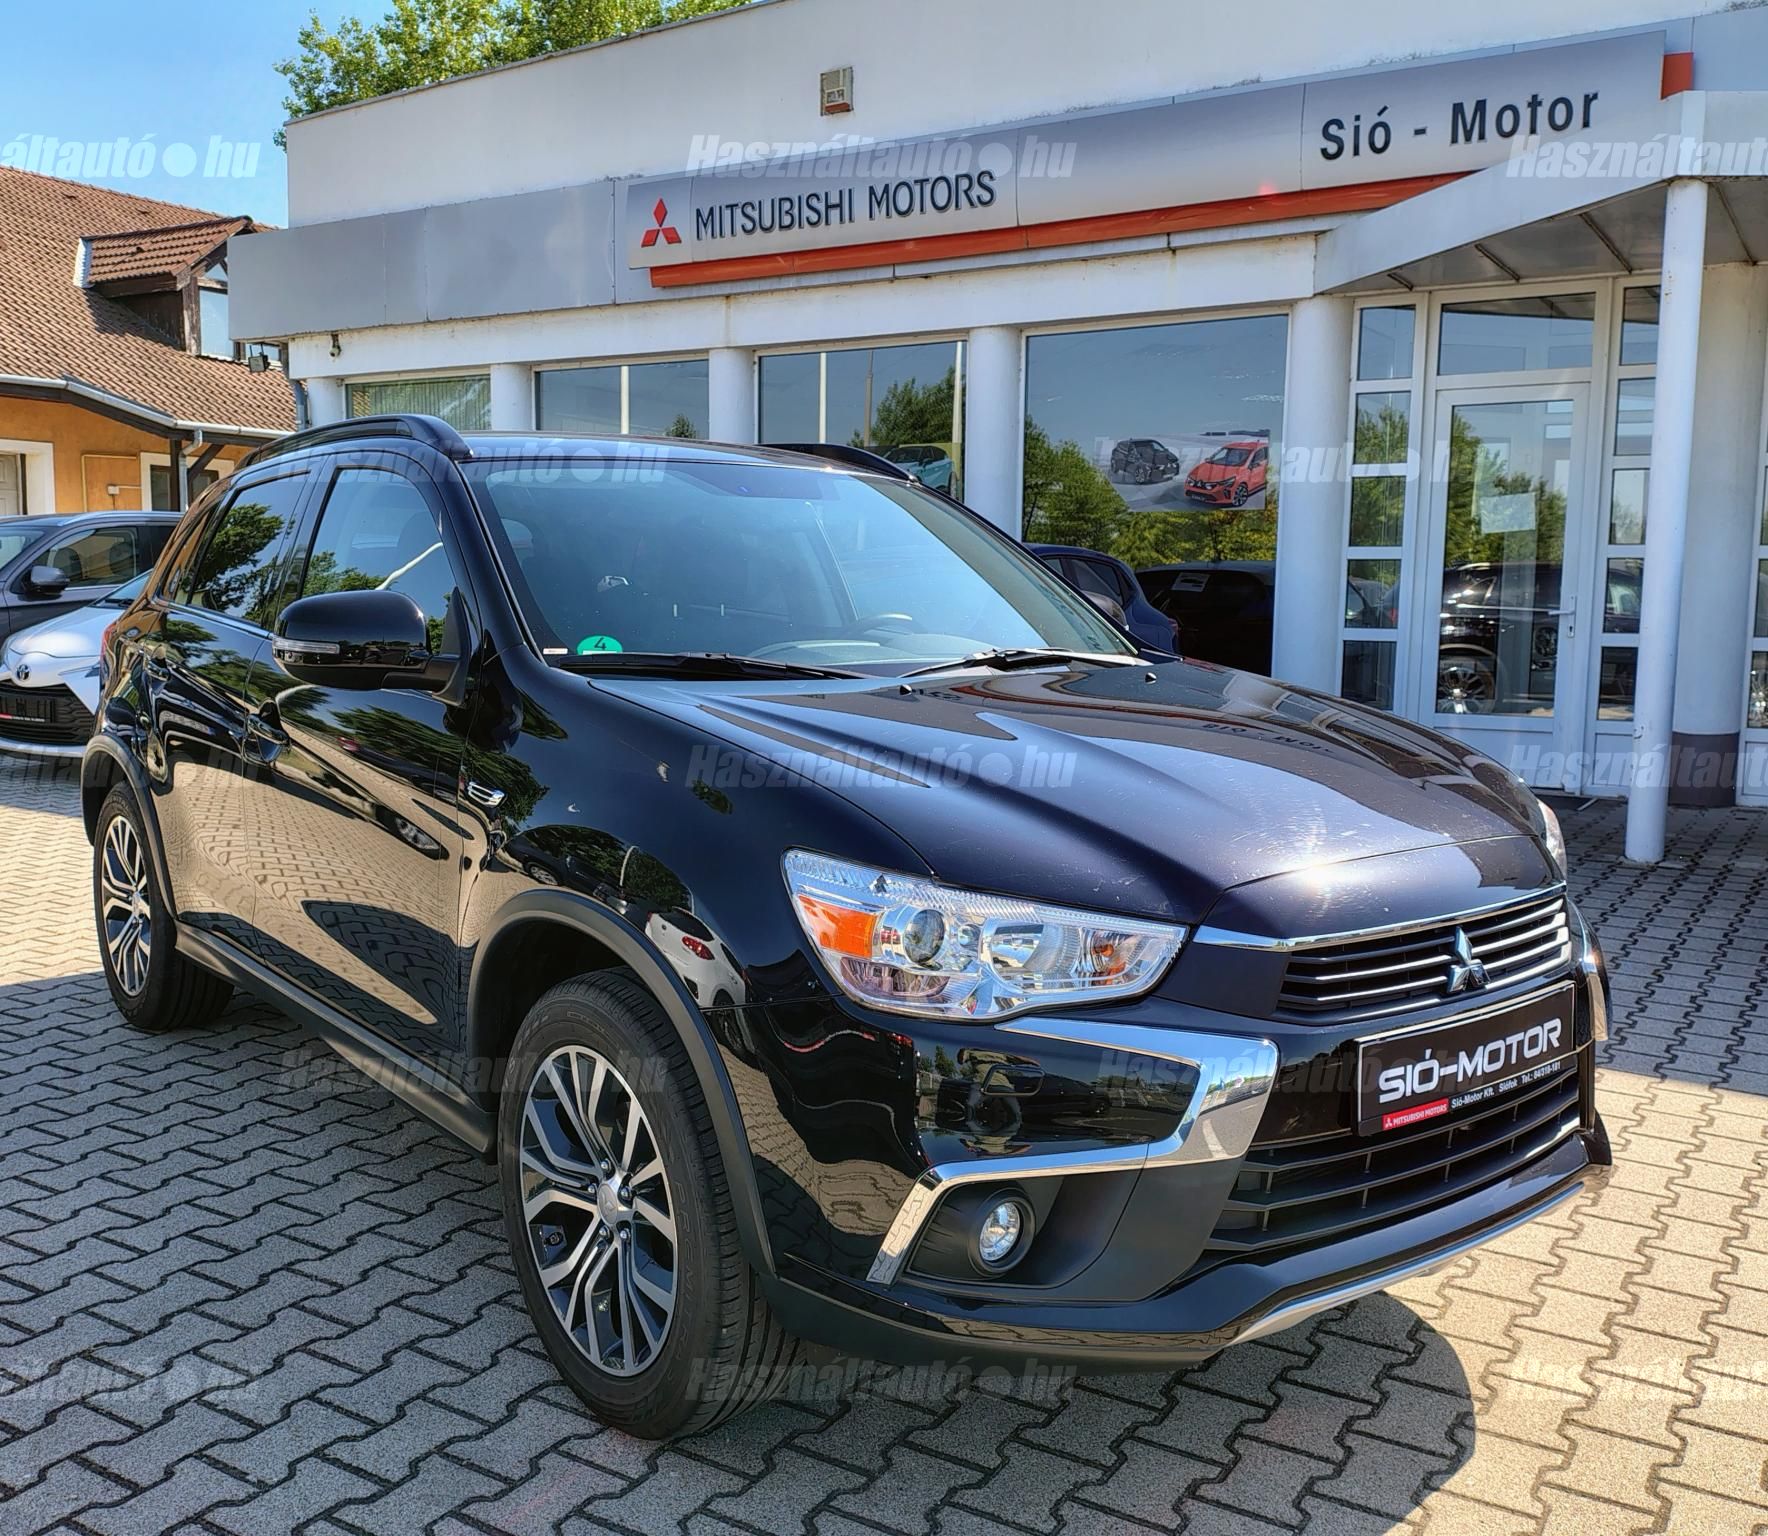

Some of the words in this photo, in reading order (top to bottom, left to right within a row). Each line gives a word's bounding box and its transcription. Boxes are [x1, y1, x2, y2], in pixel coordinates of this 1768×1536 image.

[1320, 105, 1391, 161] Sió
[1450, 91, 1599, 146] Motor
[695, 187, 855, 241] MITSUBISHI
[868, 169, 996, 222] MOTORS
[594, 636, 607, 651] 4
[1378, 1017, 1562, 1104] SIÓ-MOTOR
[1392, 1110, 1424, 1127] MITSUBISHI
[1424, 1103, 1447, 1118] MOTORS
[1451, 1091, 1483, 1109] Sió-Motor
[1498, 1078, 1518, 1093] Siófok
